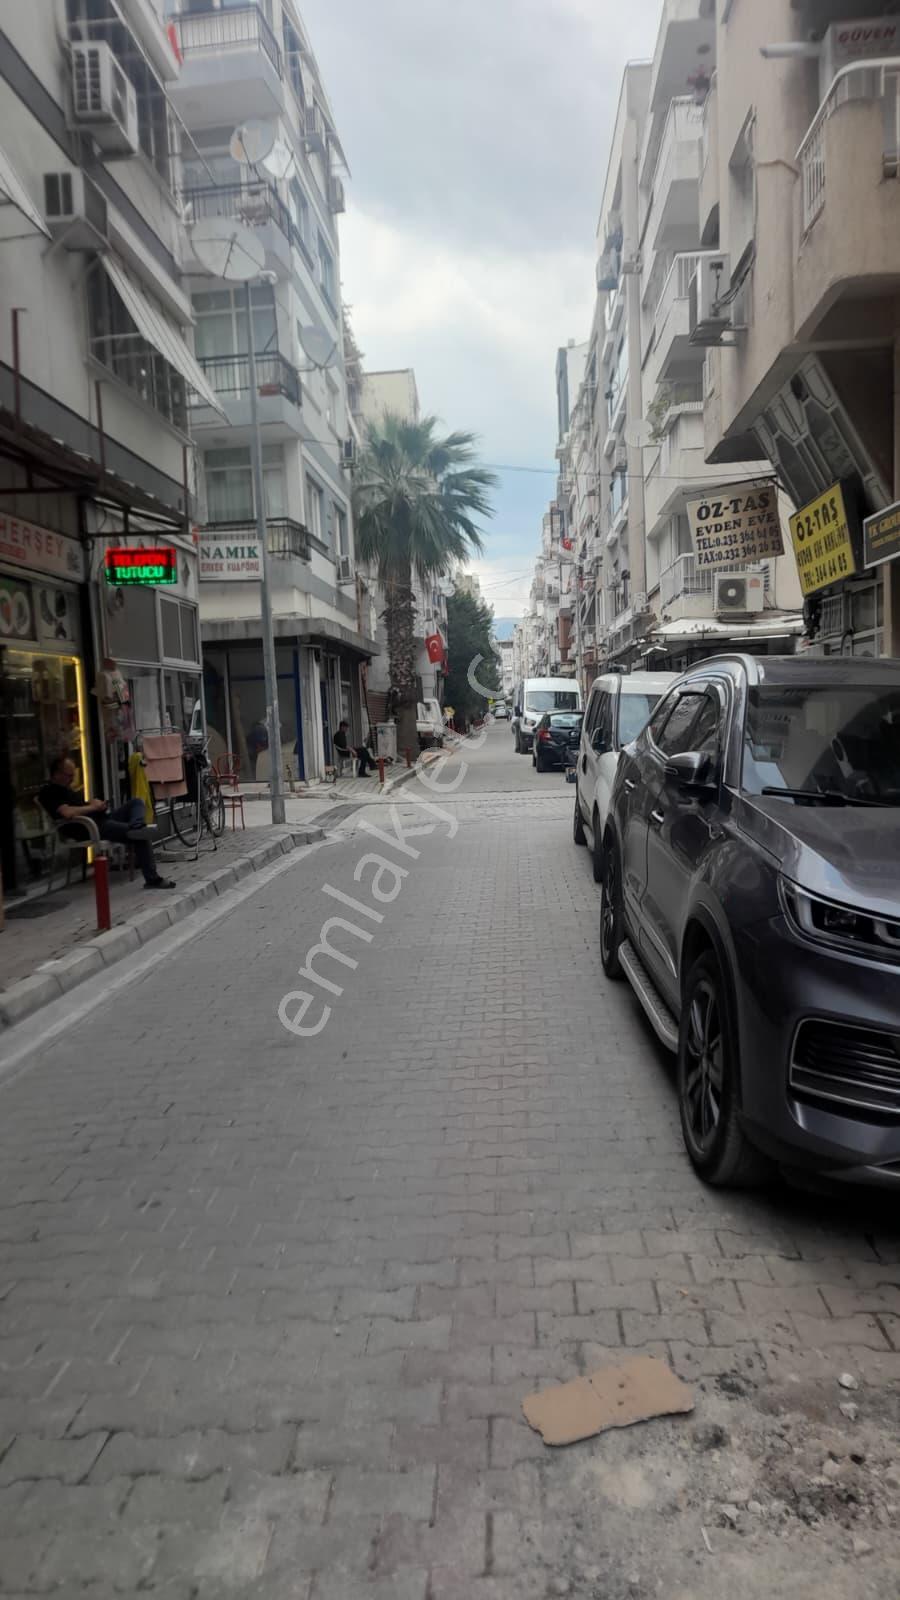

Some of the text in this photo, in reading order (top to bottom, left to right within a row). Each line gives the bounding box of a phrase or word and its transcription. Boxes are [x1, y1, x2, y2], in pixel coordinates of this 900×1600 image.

[696, 512, 775, 537] EVDEN EVE
[796, 497, 839, 541] ÖZ-TAŞ
[201, 545, 258, 560] NAMIK
[115, 566, 164, 579] TUTUCU
